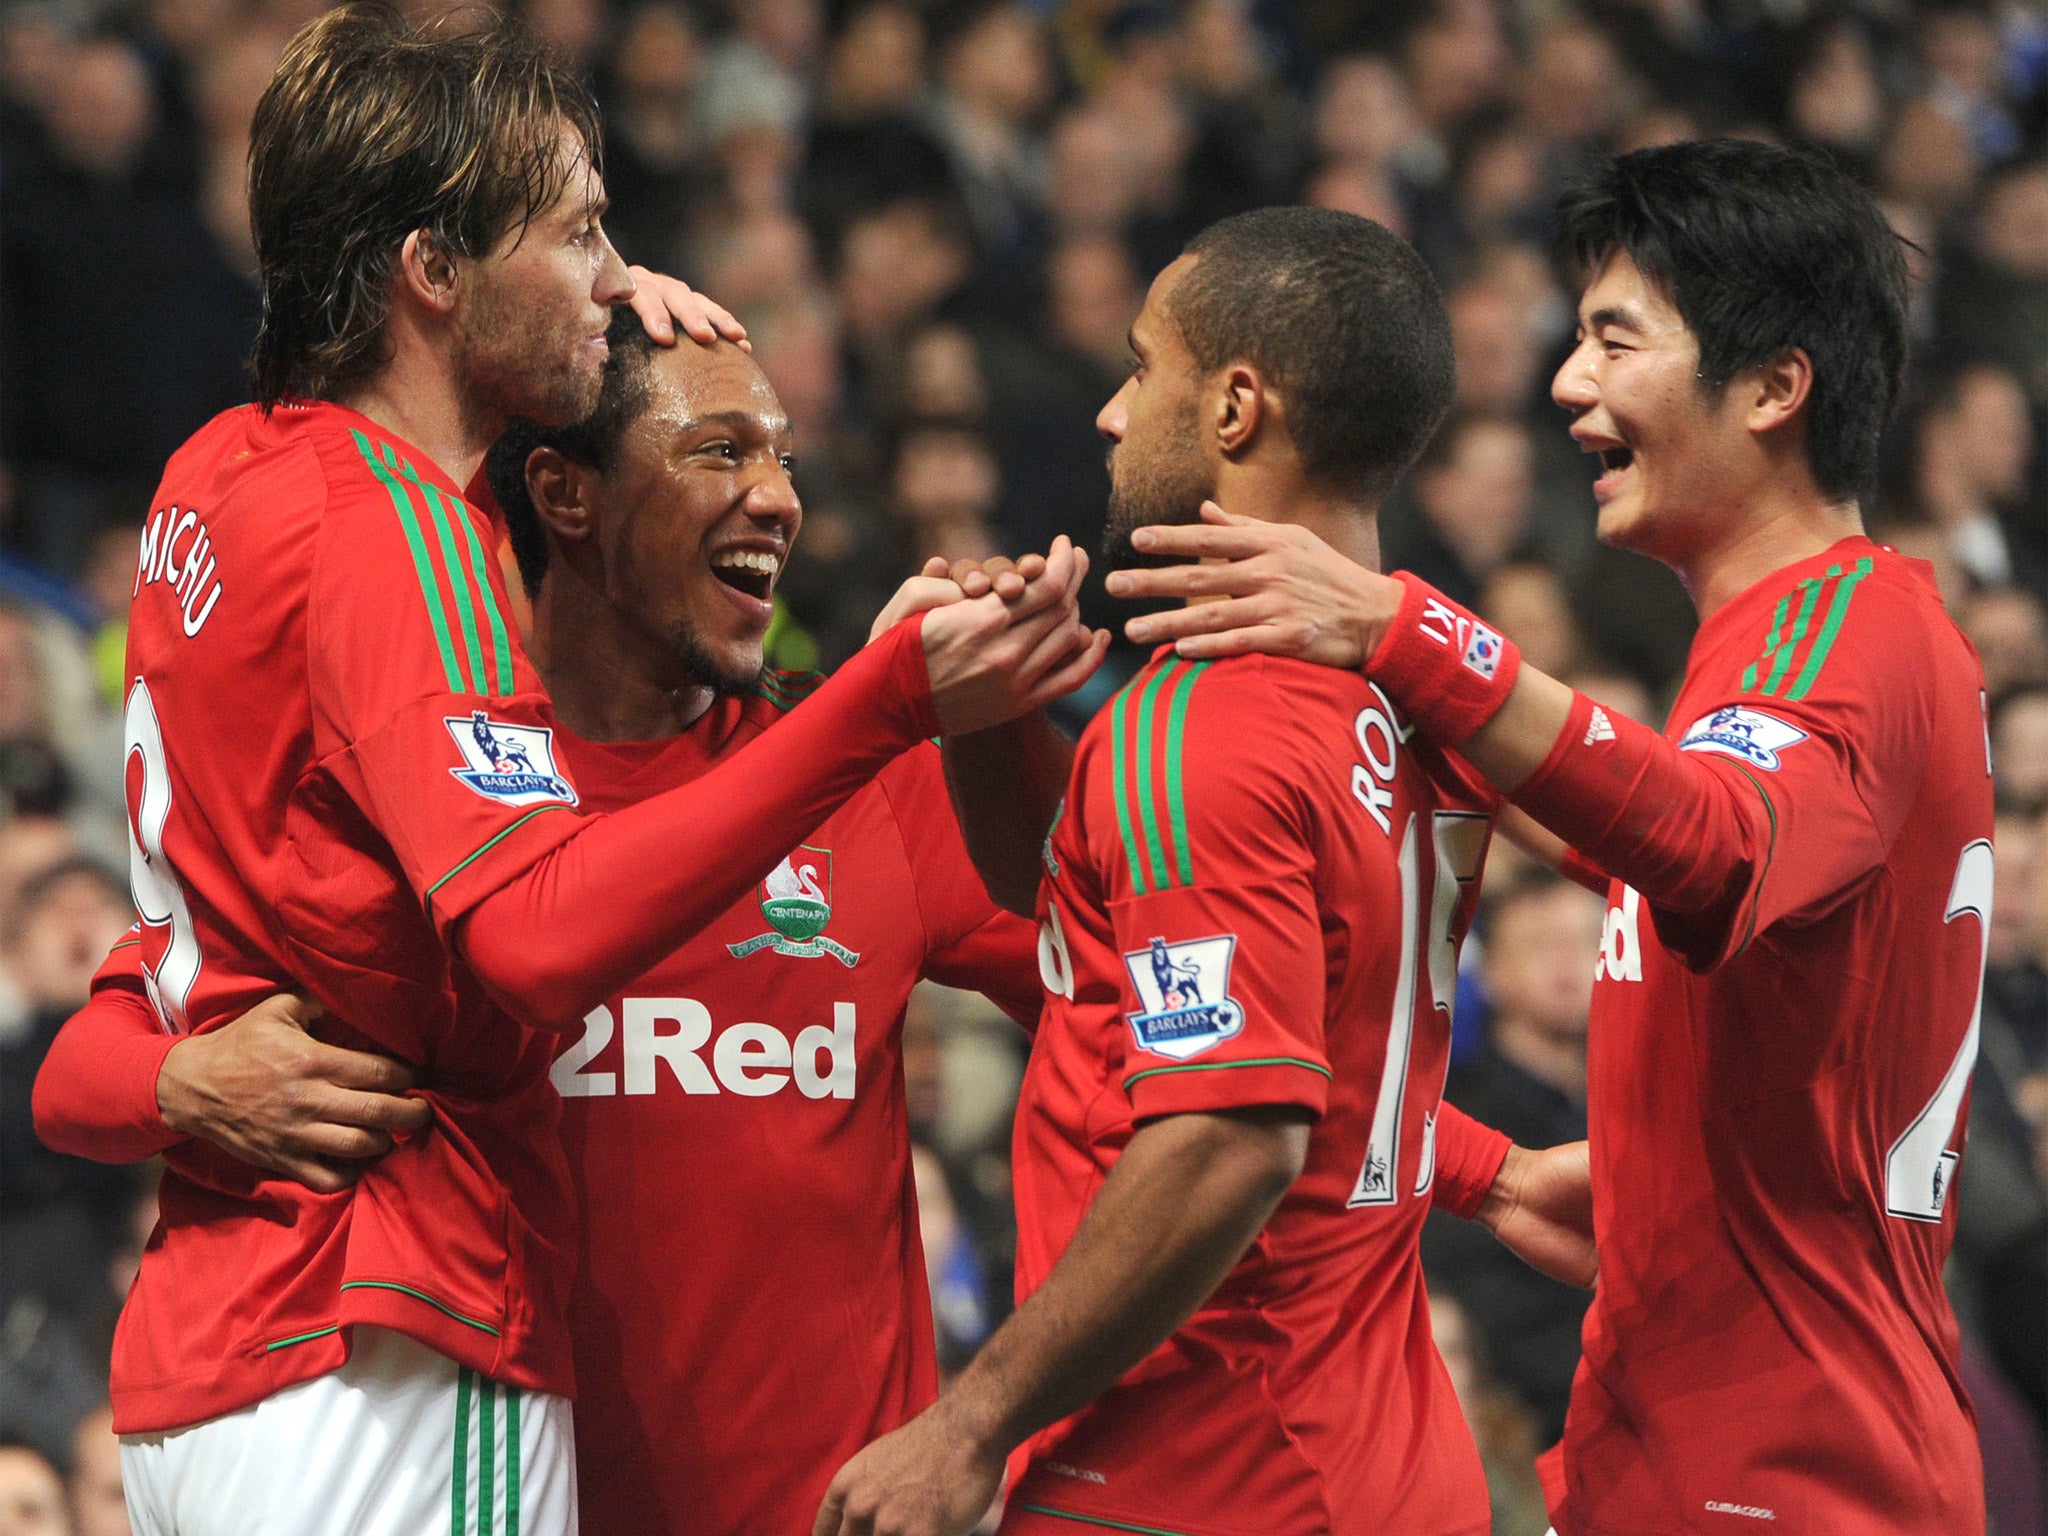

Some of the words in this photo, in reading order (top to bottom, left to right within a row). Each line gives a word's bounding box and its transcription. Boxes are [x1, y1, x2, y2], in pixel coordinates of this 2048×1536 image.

[132, 503, 223, 638] MICHU
[1419, 597, 1456, 645] KI
[480, 775, 548, 788] BARCLAYS
[124, 676, 203, 1036] 9
[769, 907, 827, 921] CENTENARY
[1147, 1009, 1208, 1034] BARCLAYS
[549, 997, 857, 1100] 2Red
